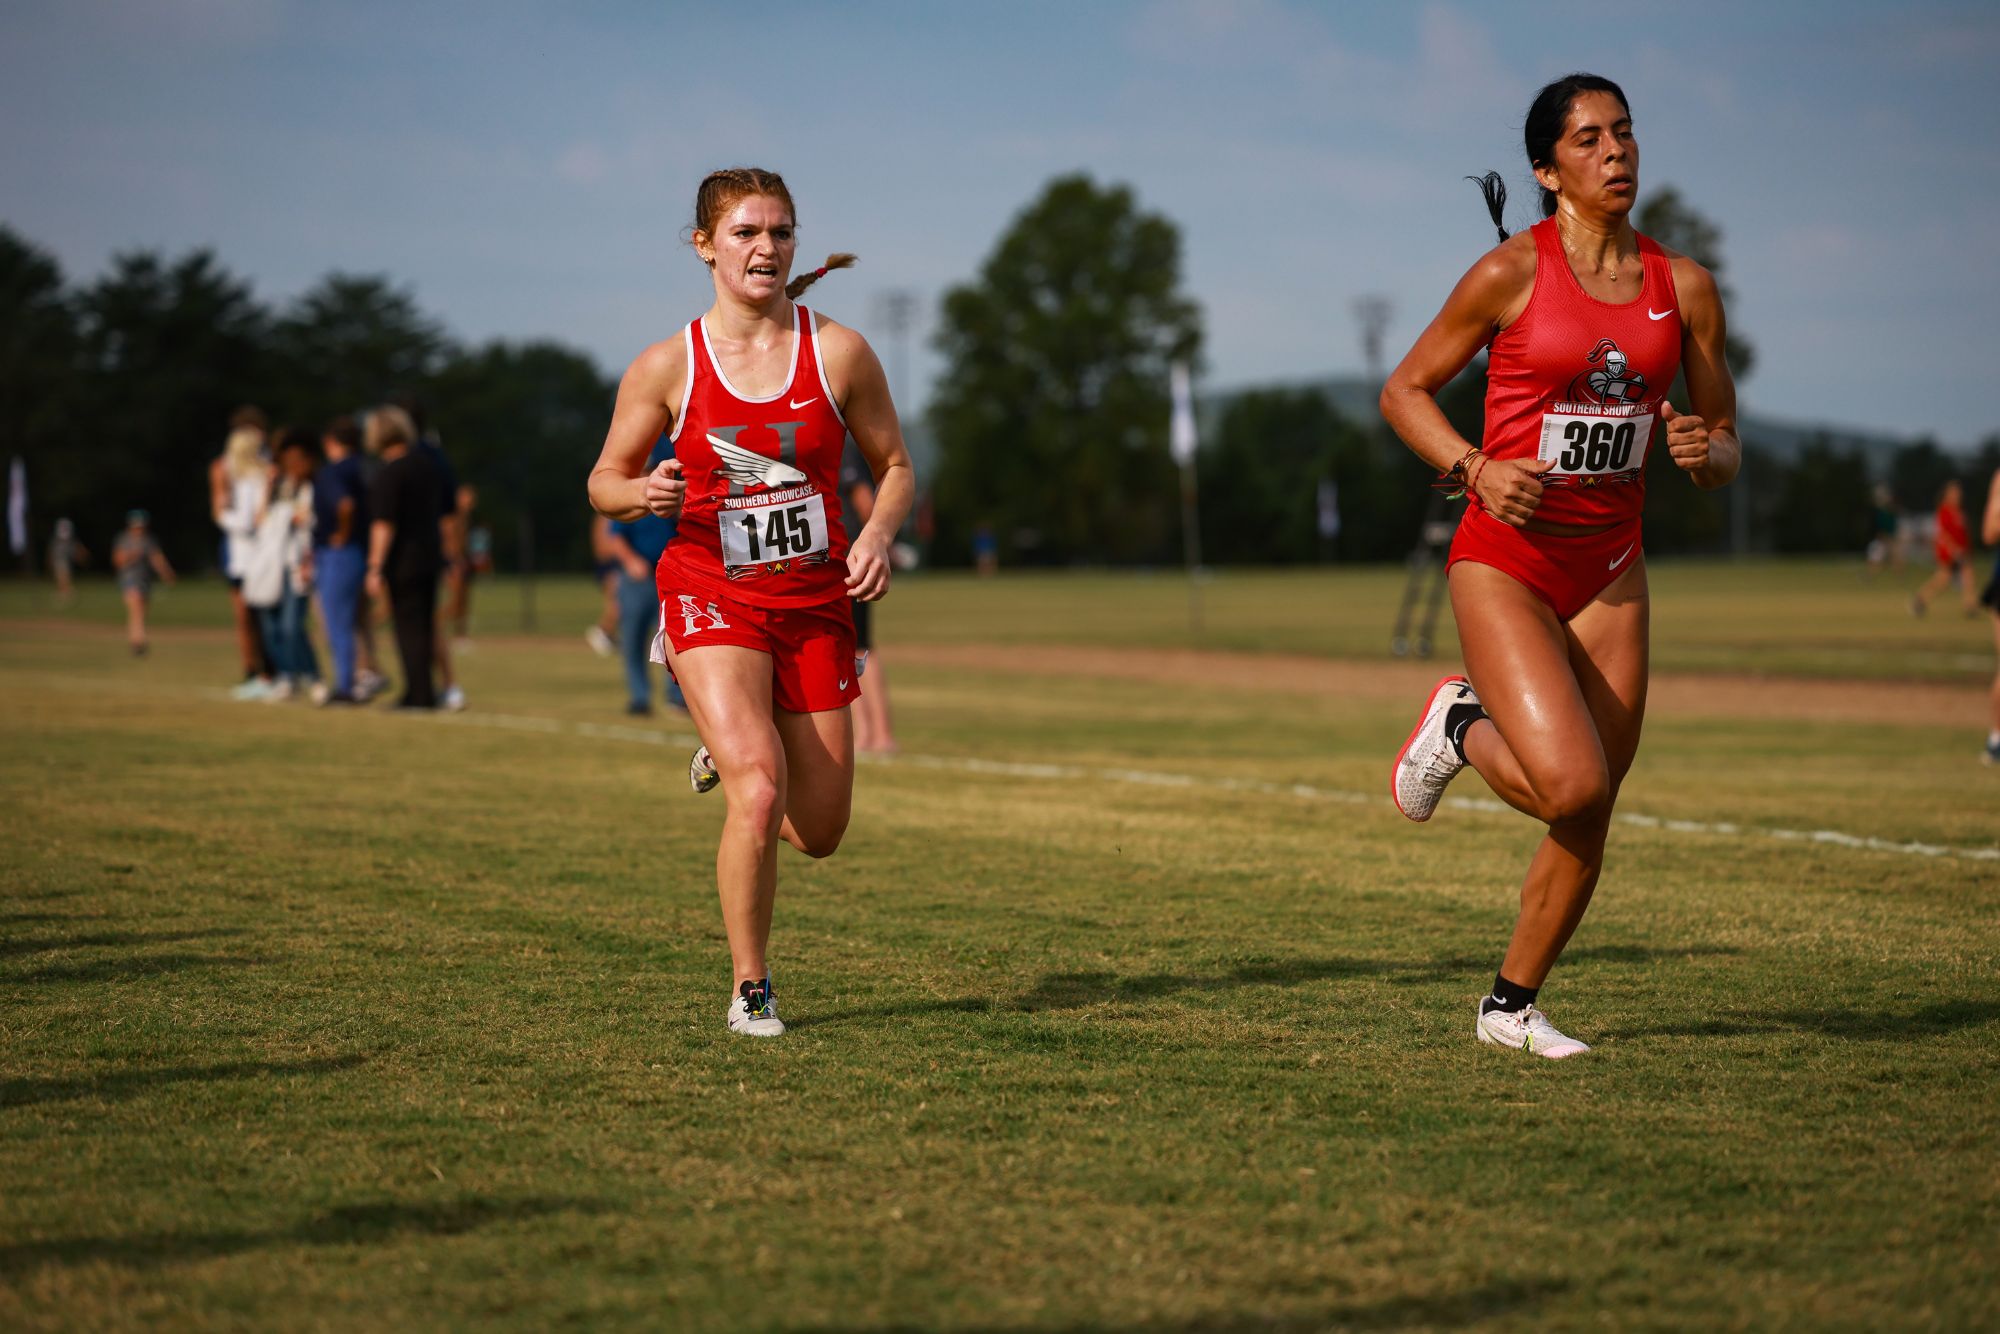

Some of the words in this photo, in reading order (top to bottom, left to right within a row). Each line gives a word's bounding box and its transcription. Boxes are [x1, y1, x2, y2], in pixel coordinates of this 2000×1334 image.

[1554, 402, 1601, 414] SOUTHERN
[1603, 403, 1648, 416] SHOWCASE
[1560, 421, 1636, 471] 360
[724, 493, 770, 509] SOUTHERN
[770, 484, 814, 503] SHOWCASE
[741, 504, 812, 560] 145
